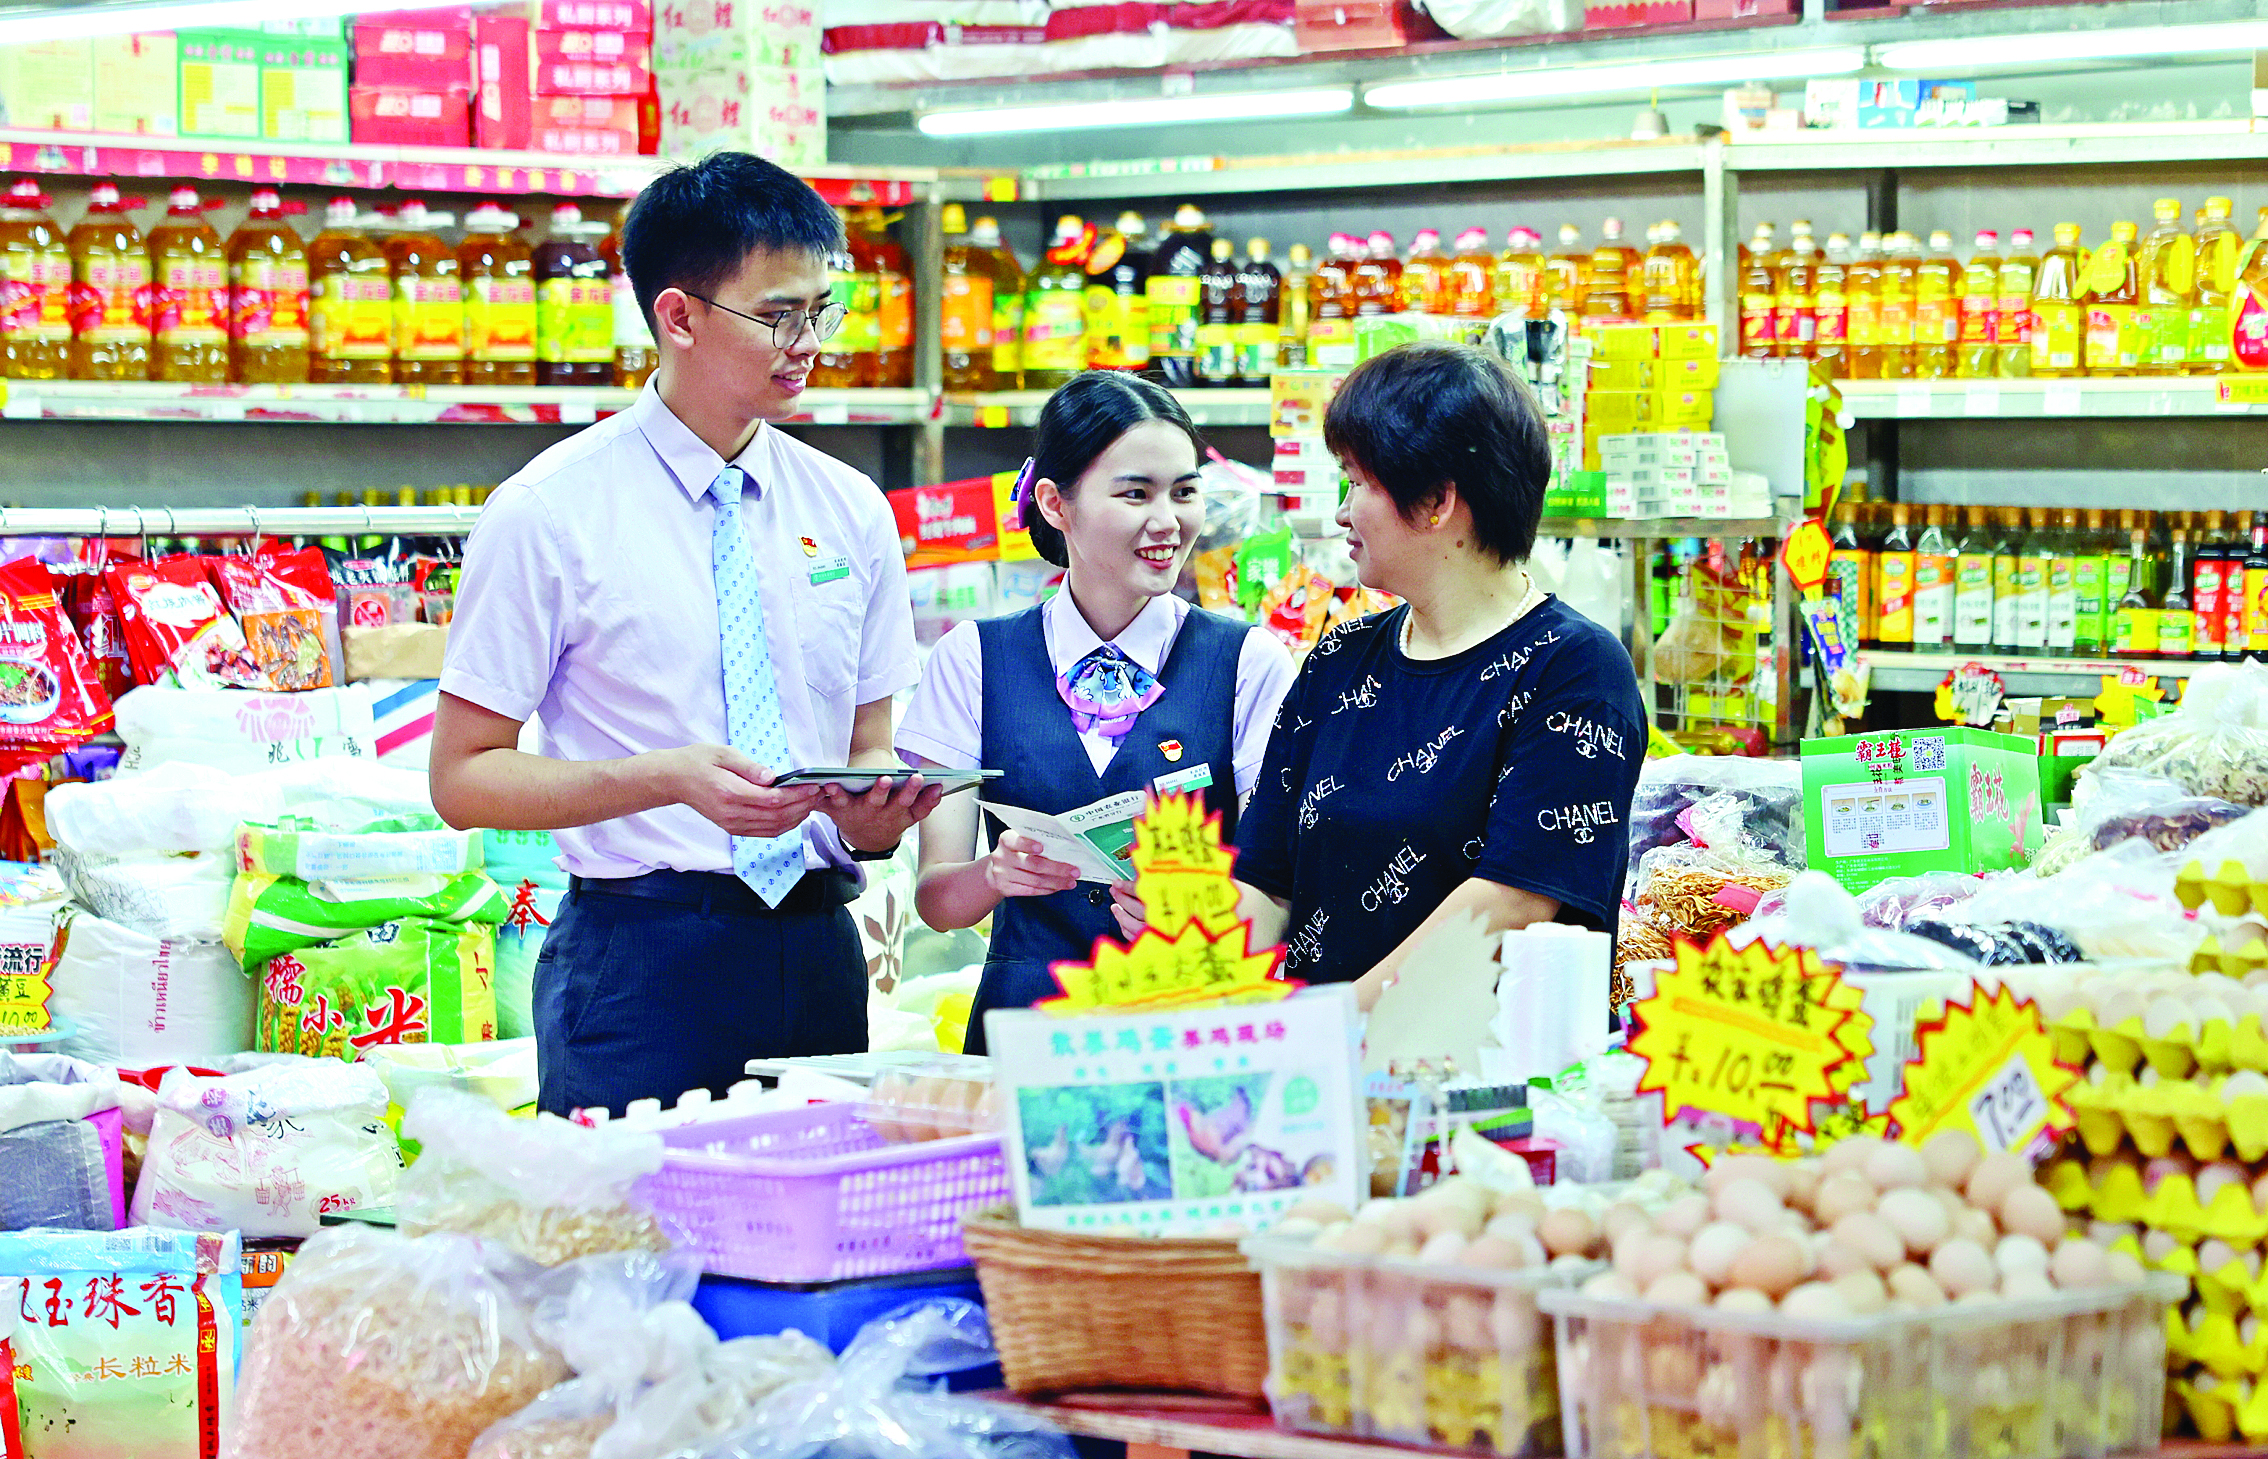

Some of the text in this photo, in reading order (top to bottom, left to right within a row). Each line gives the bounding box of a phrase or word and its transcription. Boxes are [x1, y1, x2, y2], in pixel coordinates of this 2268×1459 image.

[1387, 725, 1465, 782] CHANEL
[1546, 710, 1626, 761] CHANEL
[1537, 800, 1619, 831] CHANEL
[1361, 845, 1427, 912] CHANEL
[0, 946, 43, 972] 流行
[94, 1352, 194, 1380] 长粒米
